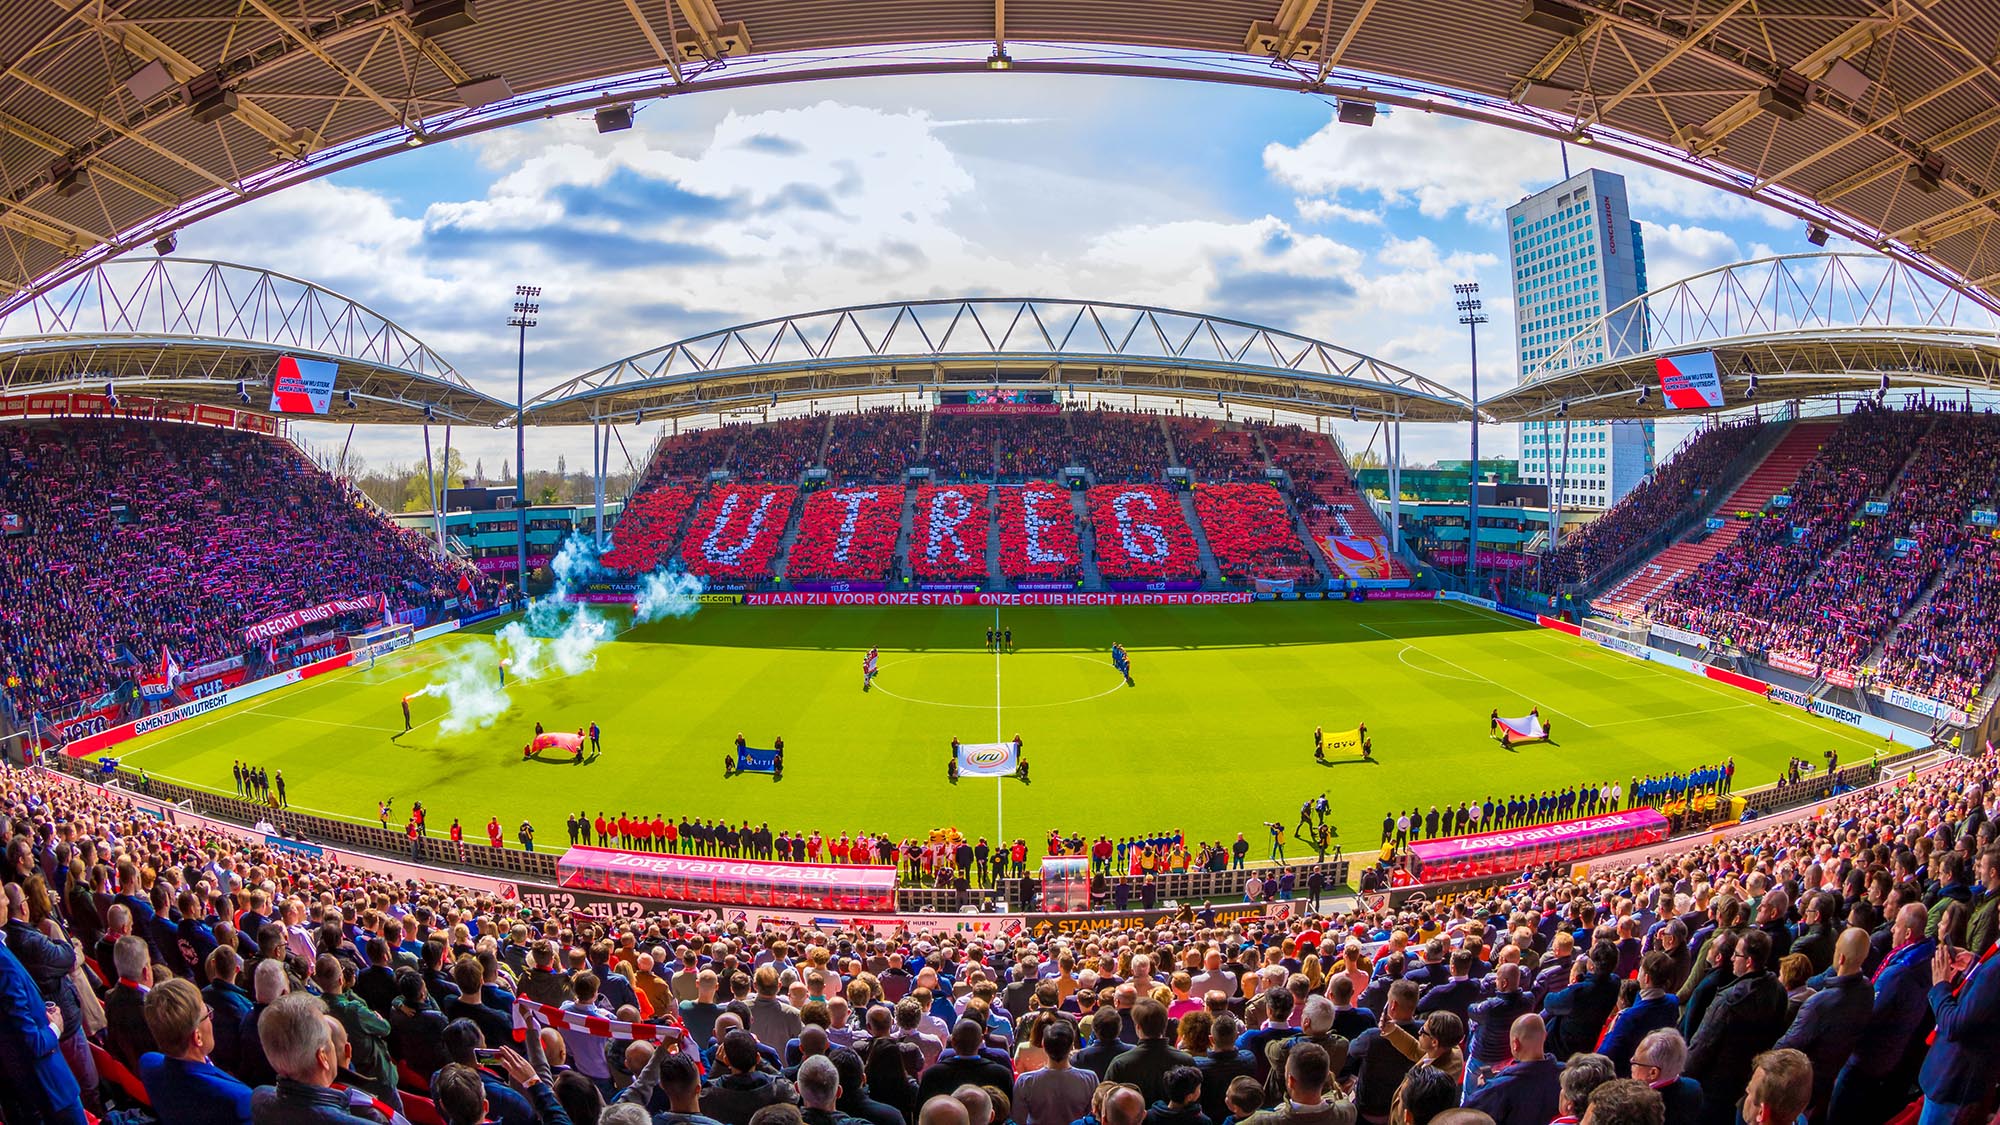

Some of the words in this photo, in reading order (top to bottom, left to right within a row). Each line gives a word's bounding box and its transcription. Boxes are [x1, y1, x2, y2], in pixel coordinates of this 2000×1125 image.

[1604, 195, 1616, 255] CONCLUSION
[935, 405, 952, 415] Zorg
[952, 405, 966, 413] van
[965, 404, 975, 413] de
[975, 405, 994, 413] Zaak
[999, 405, 1017, 415] Zorg
[1017, 405, 1031, 413] van
[1031, 405, 1041, 413] de
[1040, 405, 1057, 413] Zaak
[499, 560, 517, 569] Zorg
[1495, 556, 1514, 568] Zorg
[590, 583, 641, 591] WERKTALENT
[748, 595, 768, 605] ZIJ
[772, 594, 804, 605] AAN
[806, 593, 828, 605] ZIJ
[833, 593, 876, 605] VOOR
[878, 593, 918, 605] ONZE
[921, 593, 963, 605] STAD
[979, 593, 1021, 606] ONZE
[1023, 593, 1063, 606] CLUB
[1067, 593, 1116, 606] HECHT
[1121, 593, 1163, 605] HARD
[1168, 593, 1188, 605] EN
[1191, 593, 1253, 605] OPRECHT
[300, 604, 335, 623] BUIGT
[337, 596, 369, 612] NOOIT
[135, 714, 163, 735] SAMEN
[163, 711, 181, 725] ZIJN
[179, 705, 195, 720] WIJ
[195, 693, 228, 714] UTRECHT
[1771, 687, 1794, 702] AMEN
[1812, 701, 1826, 713] WIJ
[1825, 704, 1862, 725] UTRECHT
[1453, 833, 1515, 850] Zorg
[1509, 828, 1552, 842] van
[1551, 823, 1575, 837] de
[1574, 814, 1630, 832] Zaak
[609, 853, 676, 873] Zorg
[676, 861, 727, 874] van
[728, 861, 766, 877] de
[766, 865, 840, 881] Zaak
[523, 893, 576, 913] TELE2
[589, 901, 644, 920] TELE2
[956, 921, 991, 933] FLEX
[1058, 916, 1145, 934] STAMHUIS
